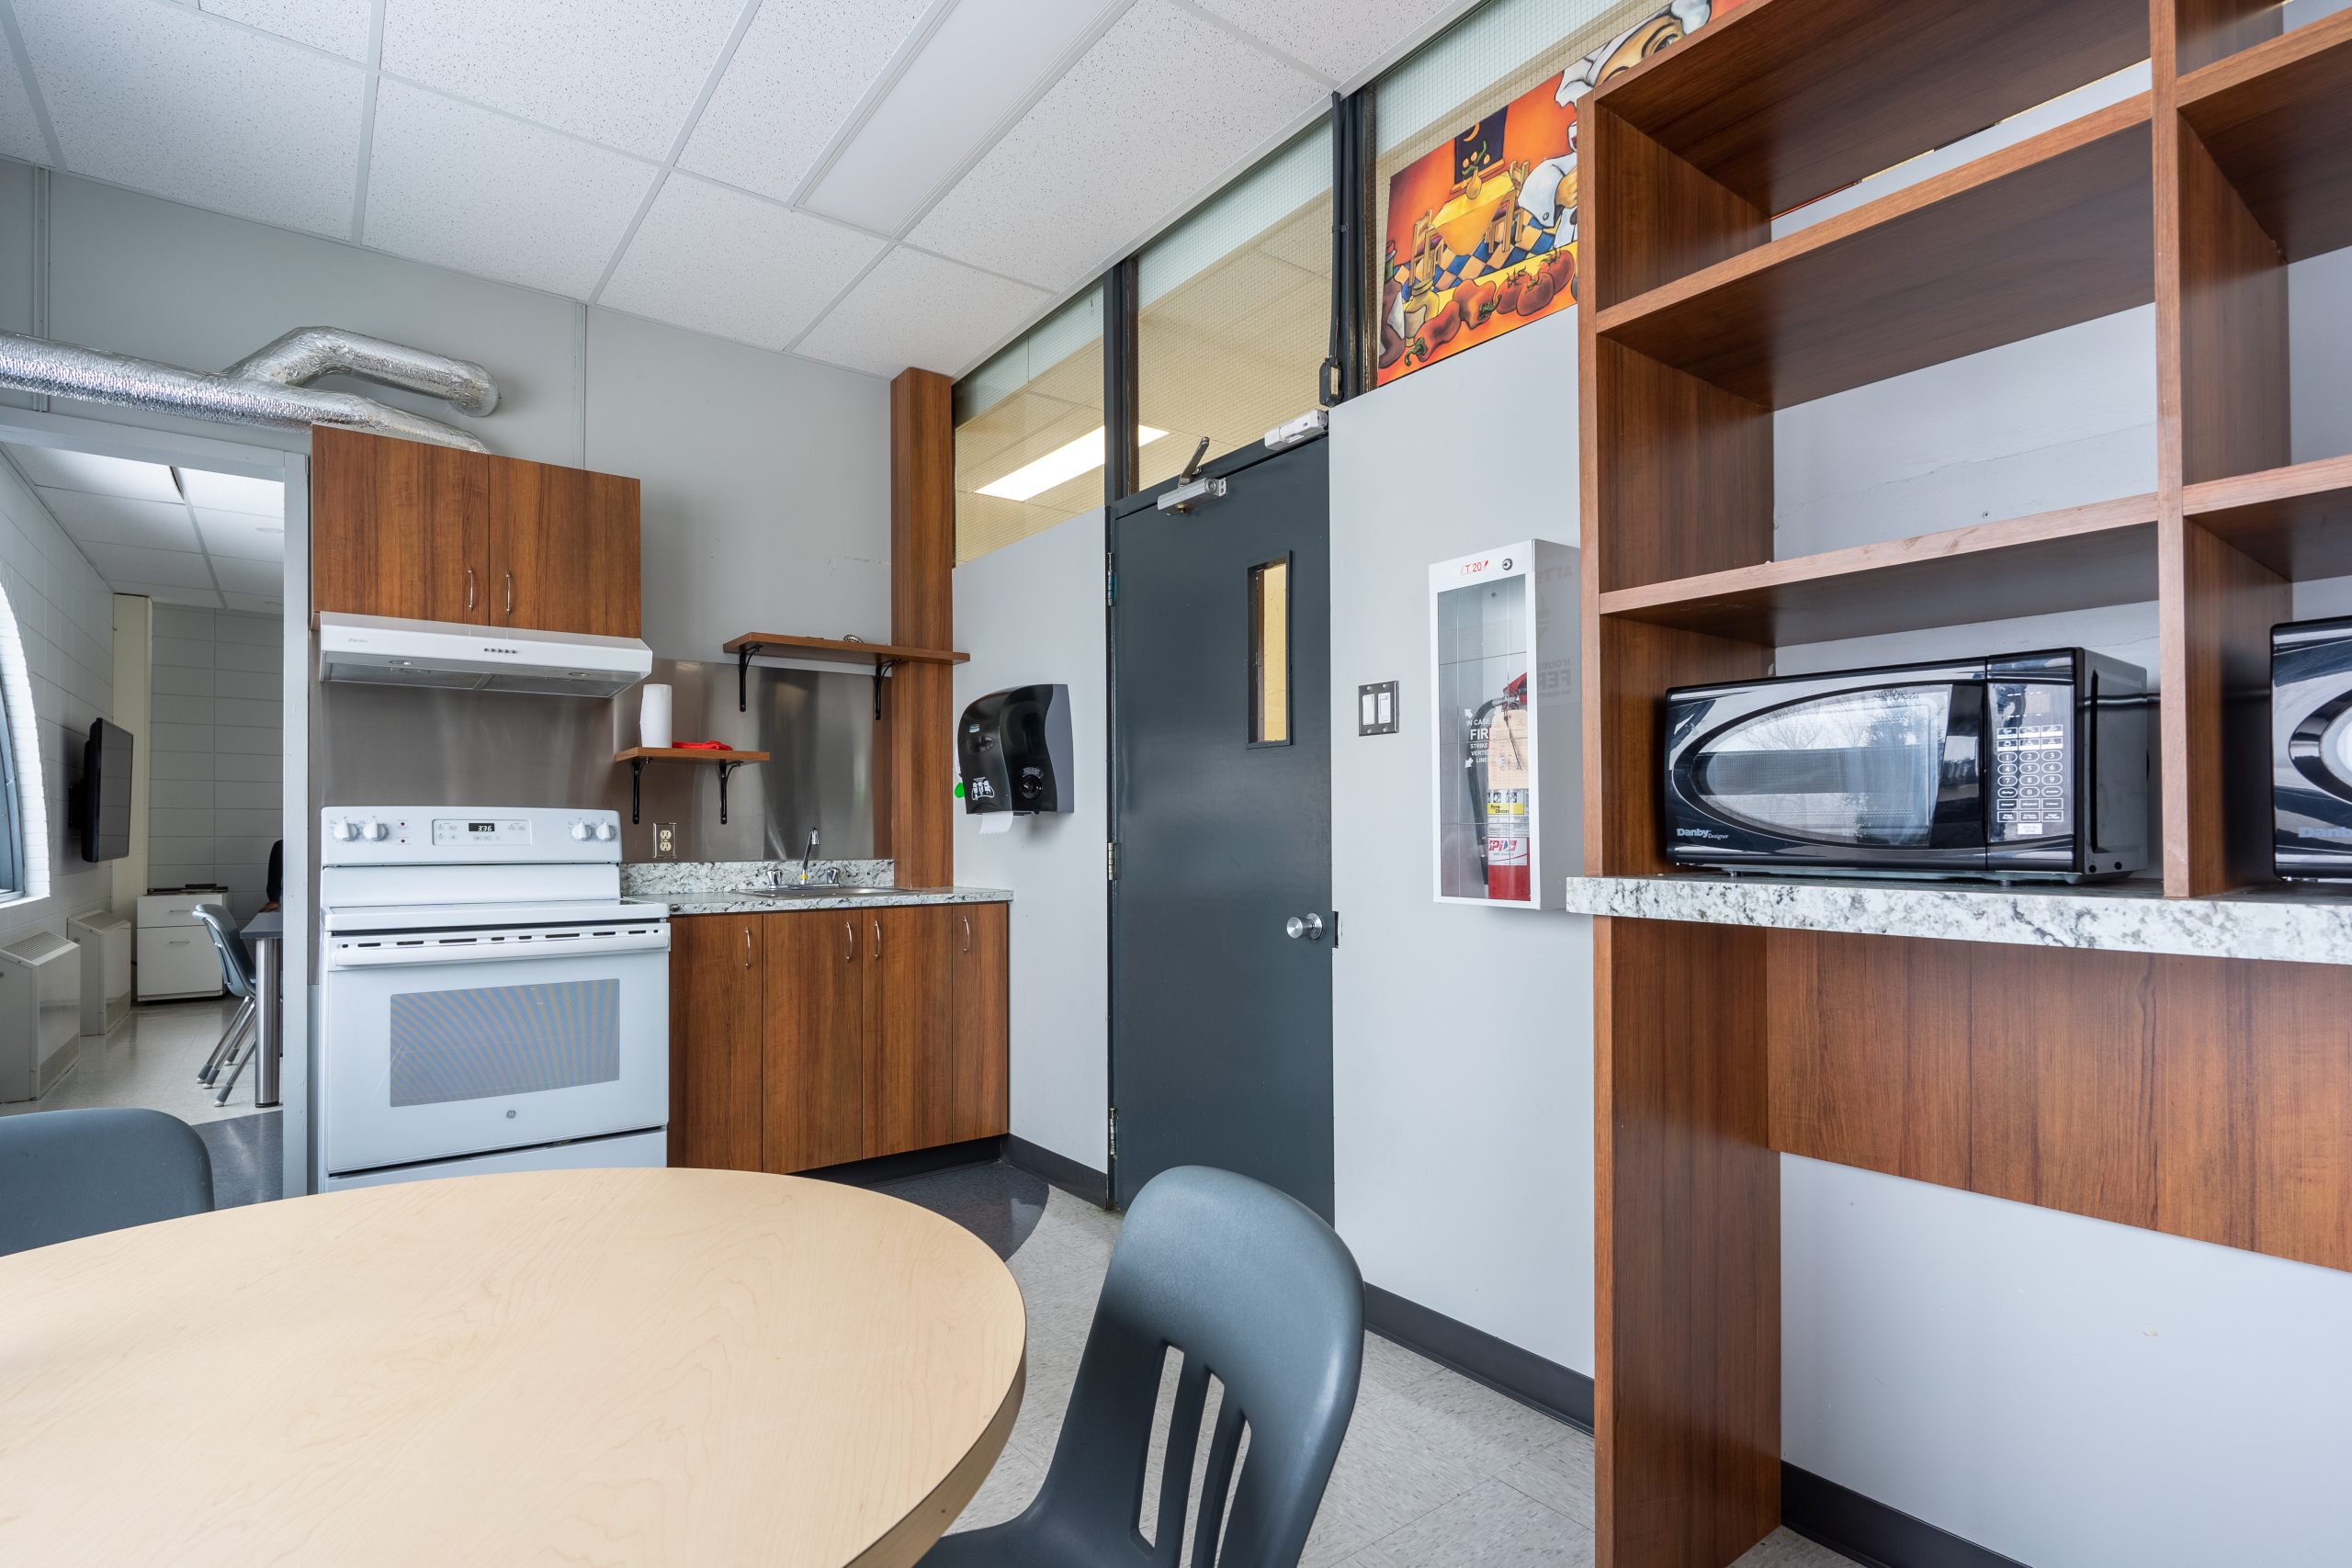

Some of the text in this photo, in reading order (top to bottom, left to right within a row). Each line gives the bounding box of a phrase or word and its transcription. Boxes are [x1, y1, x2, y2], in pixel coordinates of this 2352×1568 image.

[1474, 717, 1491, 726] CASE
[1470, 728, 1489, 740] FIR
[1677, 828, 1710, 839] Danby
[2298, 827, 2352, 838] Danb
